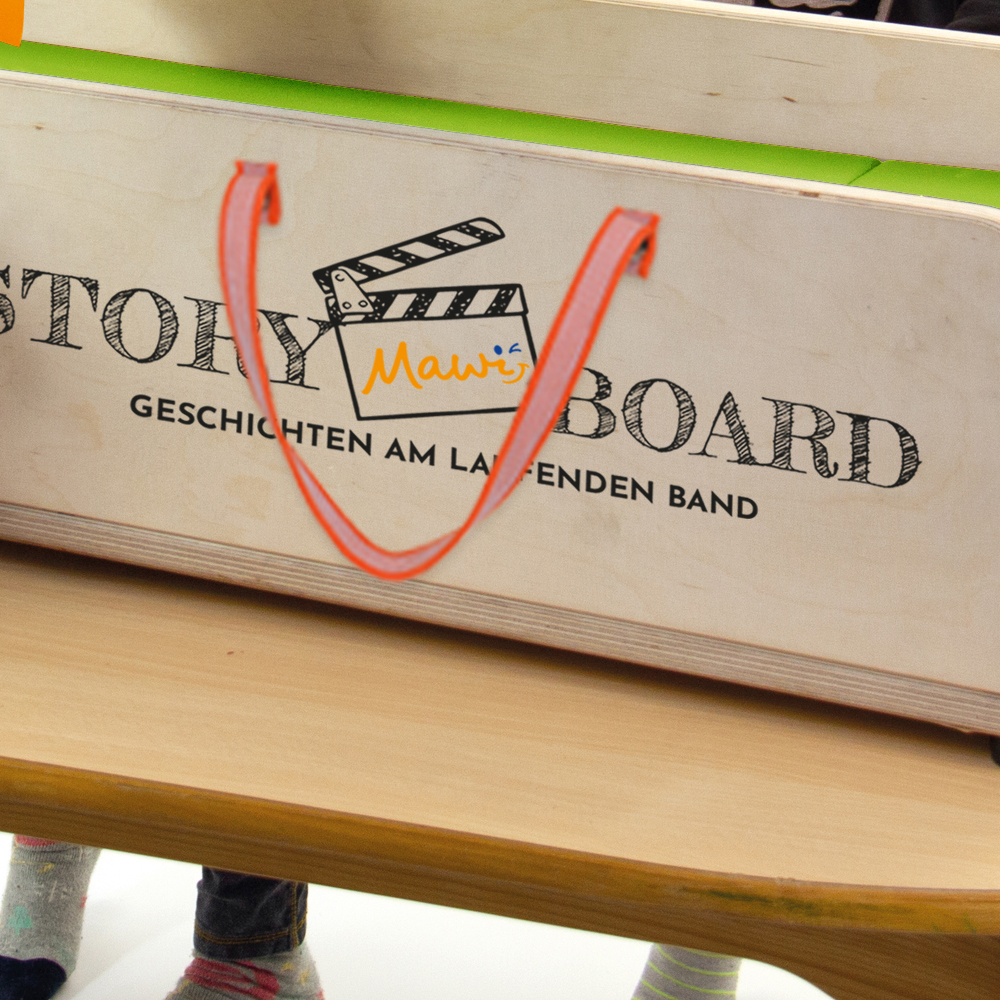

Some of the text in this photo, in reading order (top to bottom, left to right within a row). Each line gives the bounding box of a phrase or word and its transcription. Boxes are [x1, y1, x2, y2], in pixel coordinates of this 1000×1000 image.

[361, 341, 517, 395] Mawi
[549, 366, 922, 489] BOARD
[130, 394, 759, 520] GESCHICHTEN AM LAENDEN BAND
